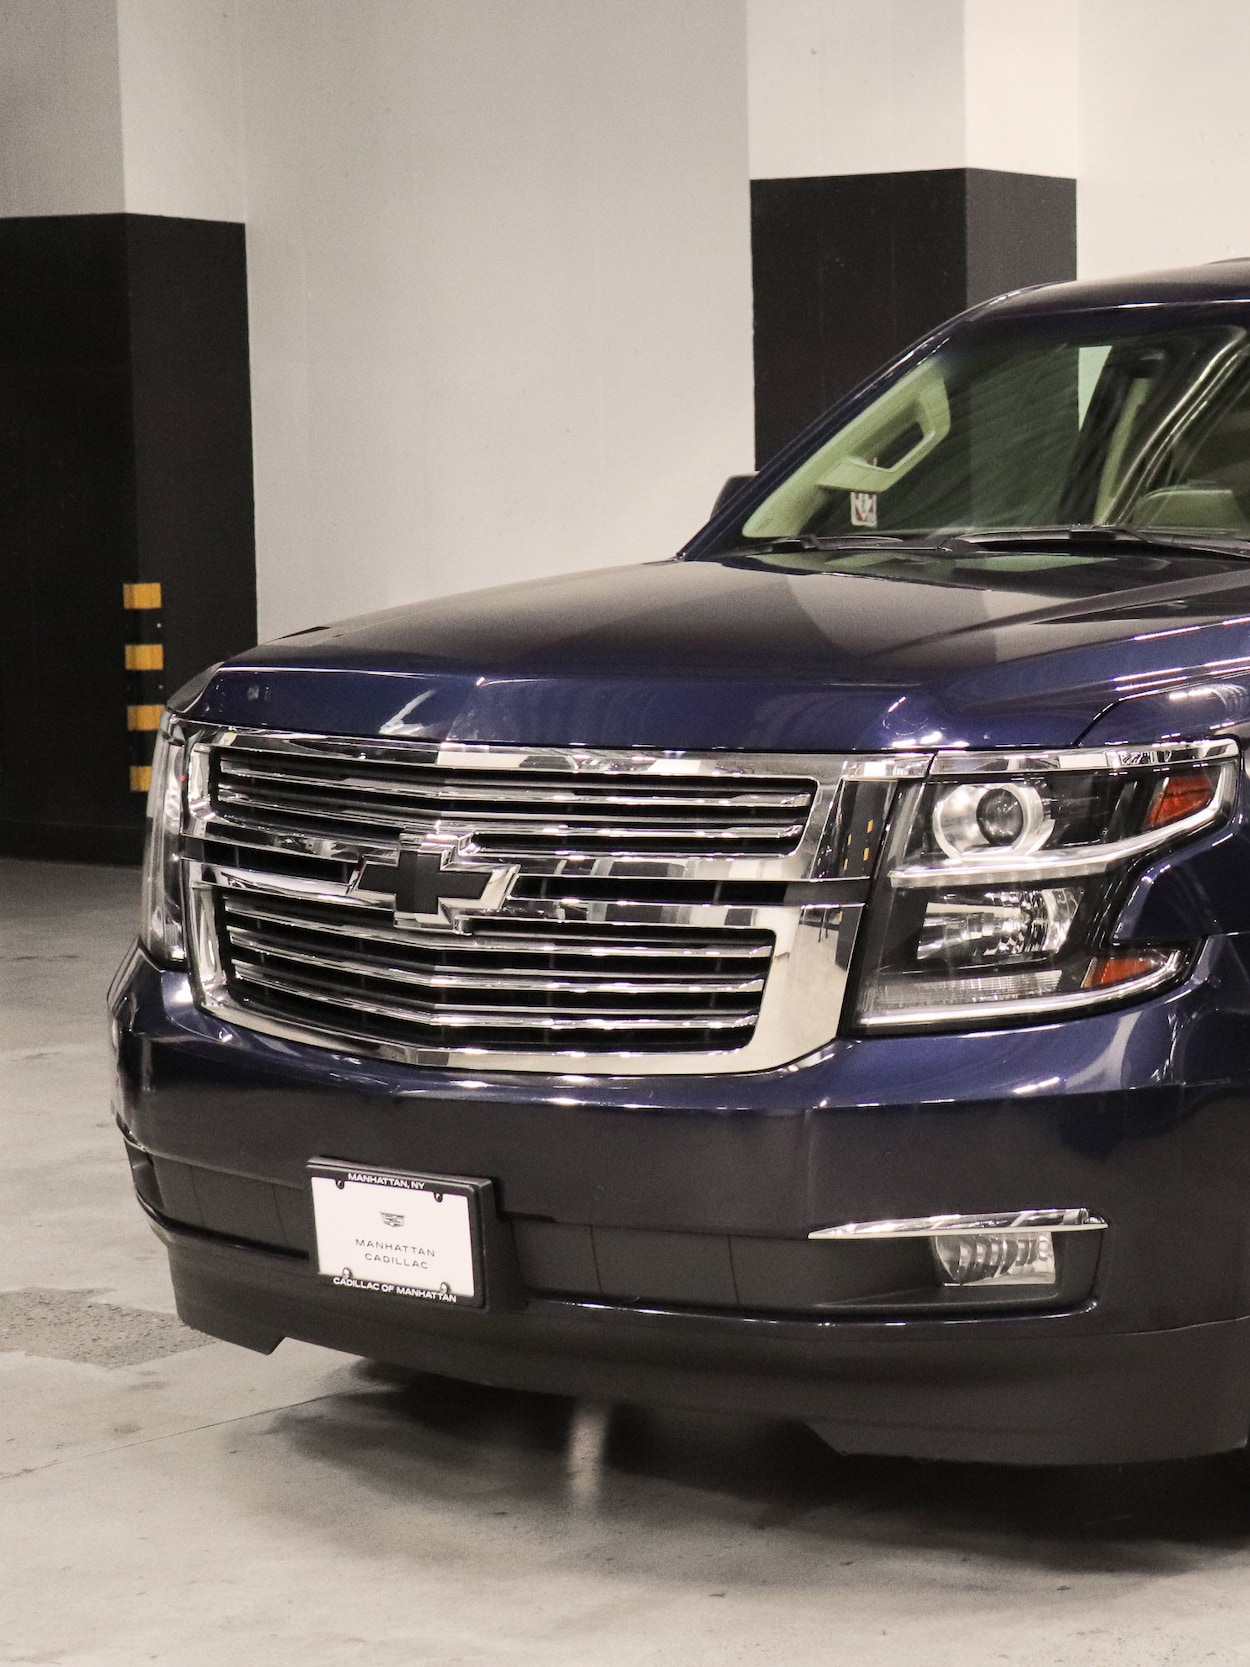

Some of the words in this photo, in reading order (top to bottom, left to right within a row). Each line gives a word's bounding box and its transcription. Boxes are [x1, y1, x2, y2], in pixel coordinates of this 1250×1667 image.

[348, 1172, 409, 1189] MANHATTAN,
[411, 1181, 425, 1190] NY
[355, 1238, 436, 1257] MANHATTAN
[364, 1253, 429, 1270] CADILLAC
[333, 1276, 380, 1291] CADILLAC
[381, 1284, 395, 1293] OF
[396, 1286, 457, 1303] MANHATTAN
